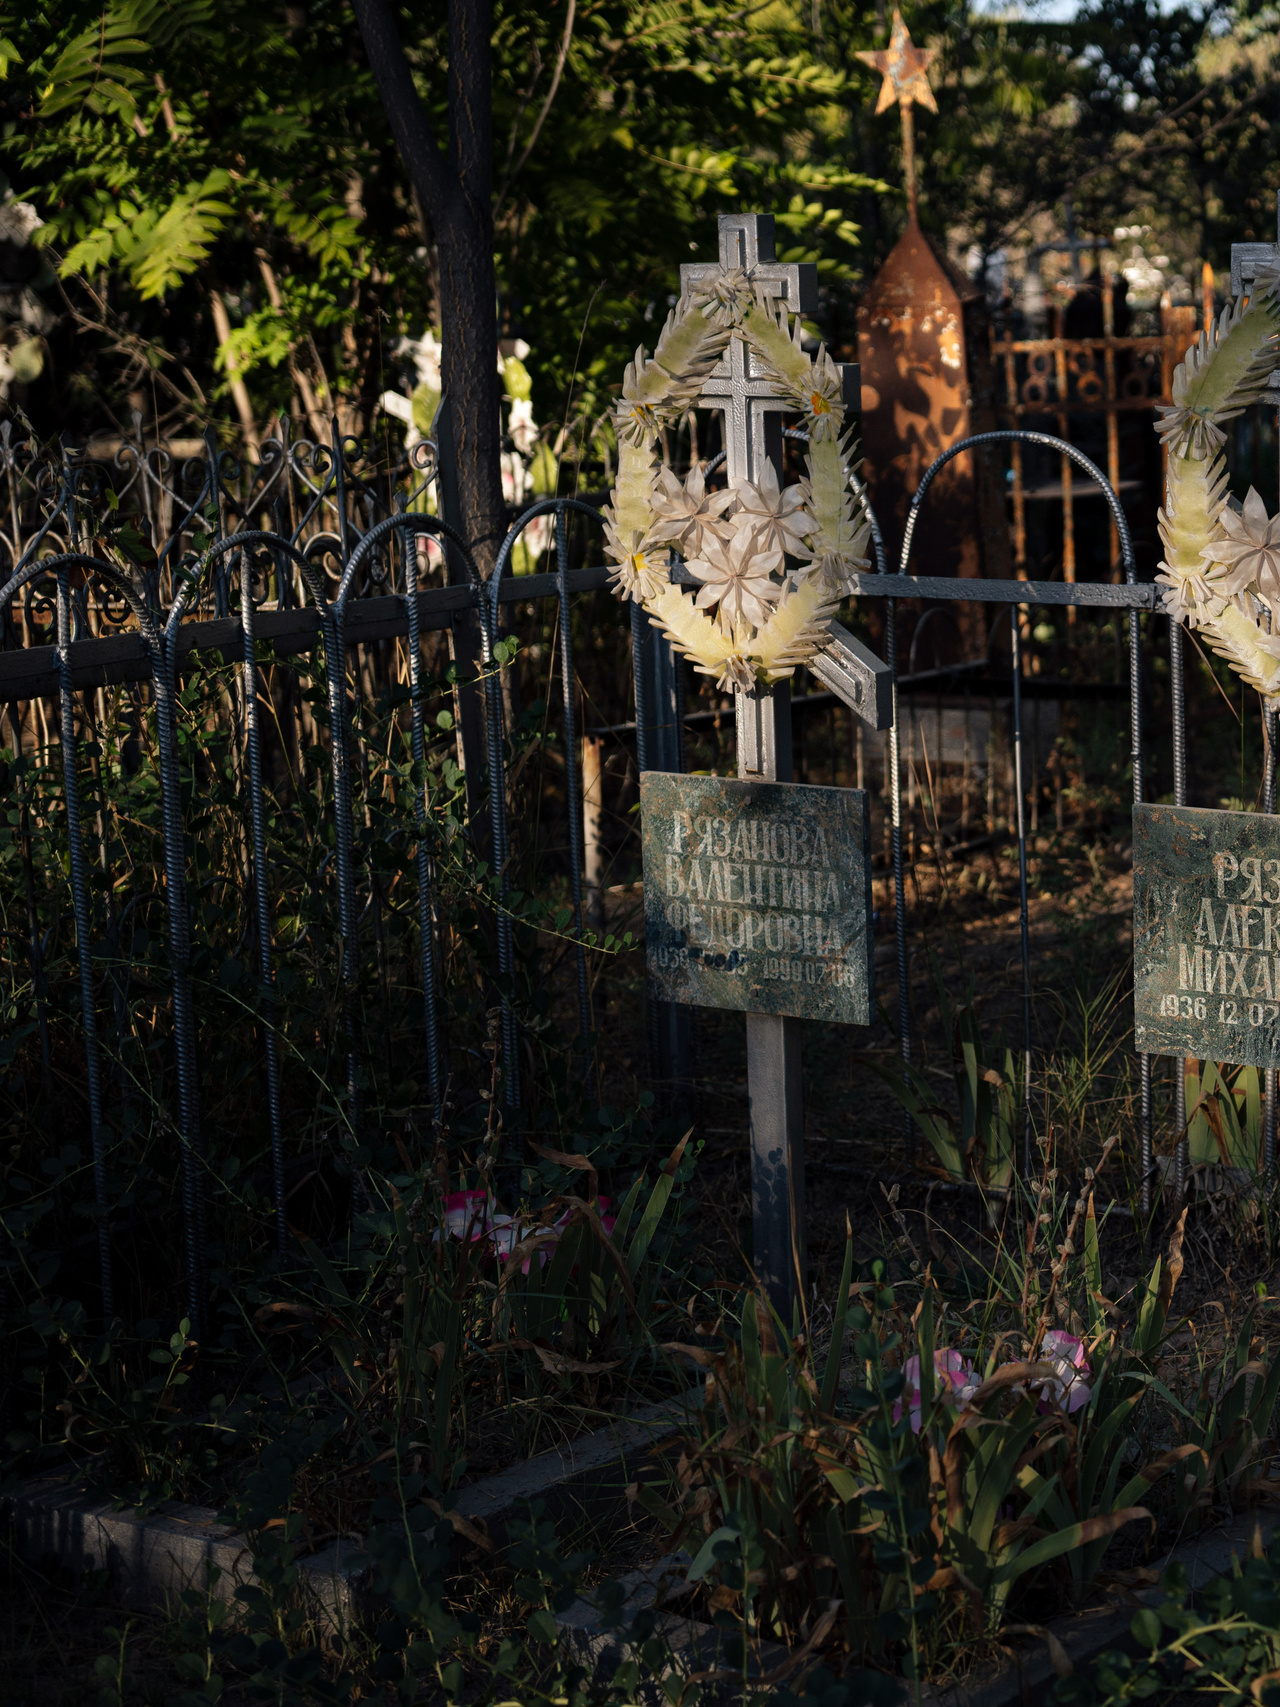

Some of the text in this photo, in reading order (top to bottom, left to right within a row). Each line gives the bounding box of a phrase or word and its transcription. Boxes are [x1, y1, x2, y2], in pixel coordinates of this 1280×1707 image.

[665, 854, 840, 912] ВАЛЕНТИНА
[1160, 993, 1207, 1021] 1936
[1218, 1000, 1239, 1024] 12
